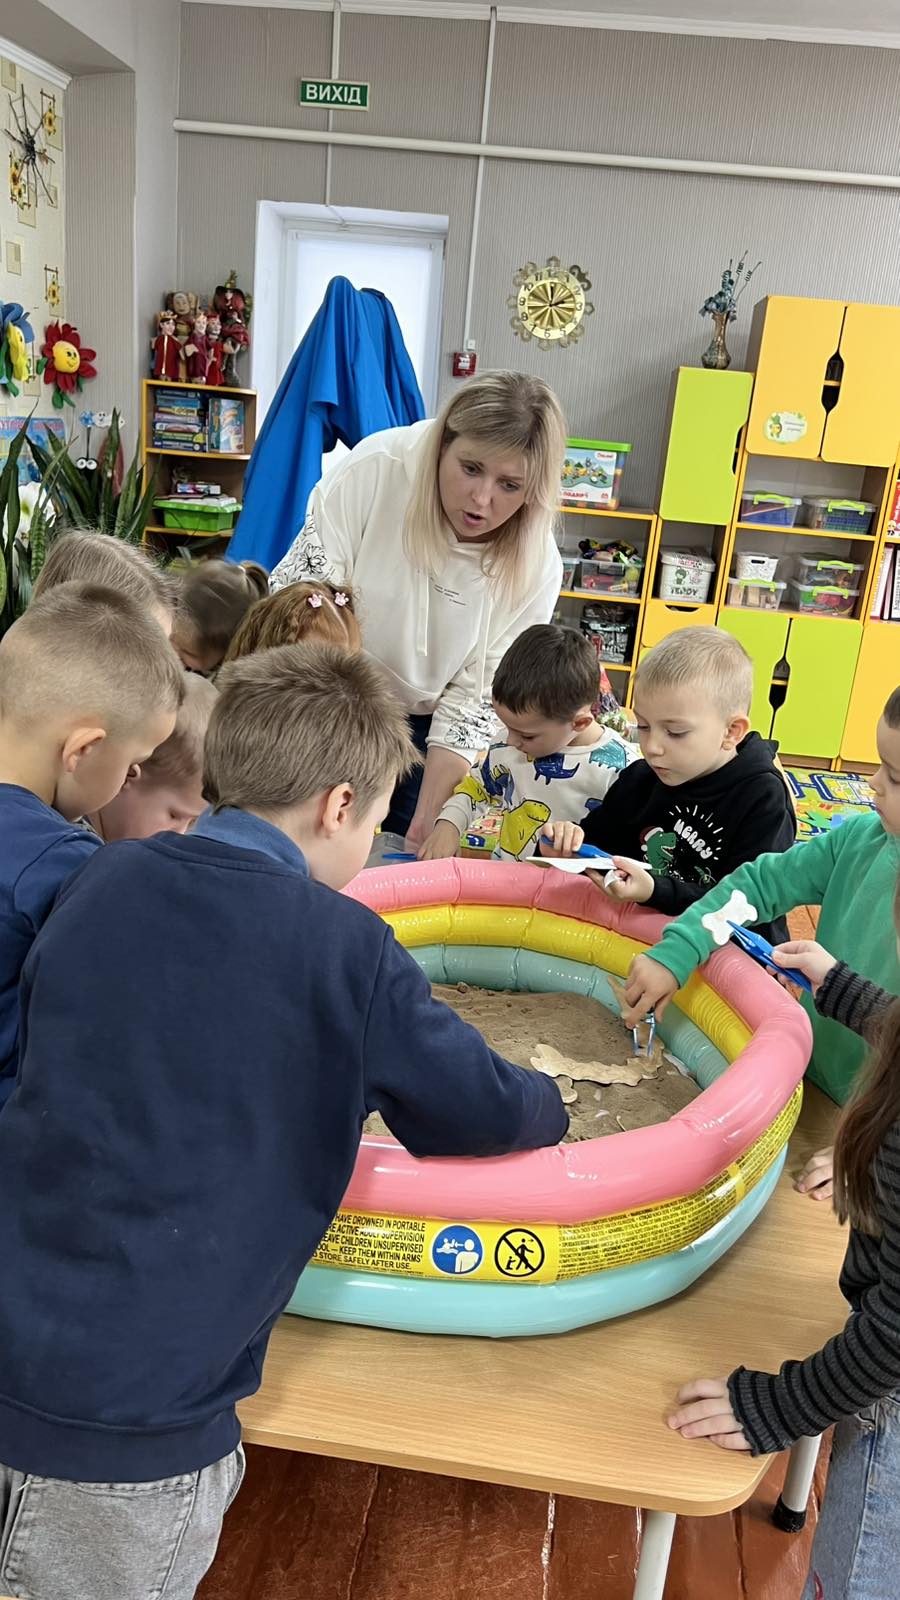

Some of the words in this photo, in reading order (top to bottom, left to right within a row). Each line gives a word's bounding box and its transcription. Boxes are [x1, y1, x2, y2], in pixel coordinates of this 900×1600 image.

[306, 84, 361, 104] ВИХІД
[574, 286, 581, 296] 2
[518, 297, 526, 306] 9
[575, 302, 583, 312] 3
[520, 312, 528, 321] 8
[335, 1214, 352, 1224] HAVE
[353, 1215, 384, 1228] DROWNED
[385, 1219, 392, 1229] IN
[393, 1220, 426, 1232] PORTABLE
[337, 1224, 359, 1236] ACTIVE
[381, 1229, 425, 1243] SUPERVISION
[339, 1245, 357, 1255] KEEP
[358, 1248, 377, 1259] THEM
[377, 1250, 401, 1261] WITHIN
[340, 1235, 372, 1249] CHILDREN
[373, 1240, 424, 1254] UNSUPERVISED
[318, 1251, 342, 1262] STORE
[343, 1255, 370, 1266] SAFELY
[371, 1259, 395, 1269] AFTER
[395, 1261, 411, 1270] USE.
